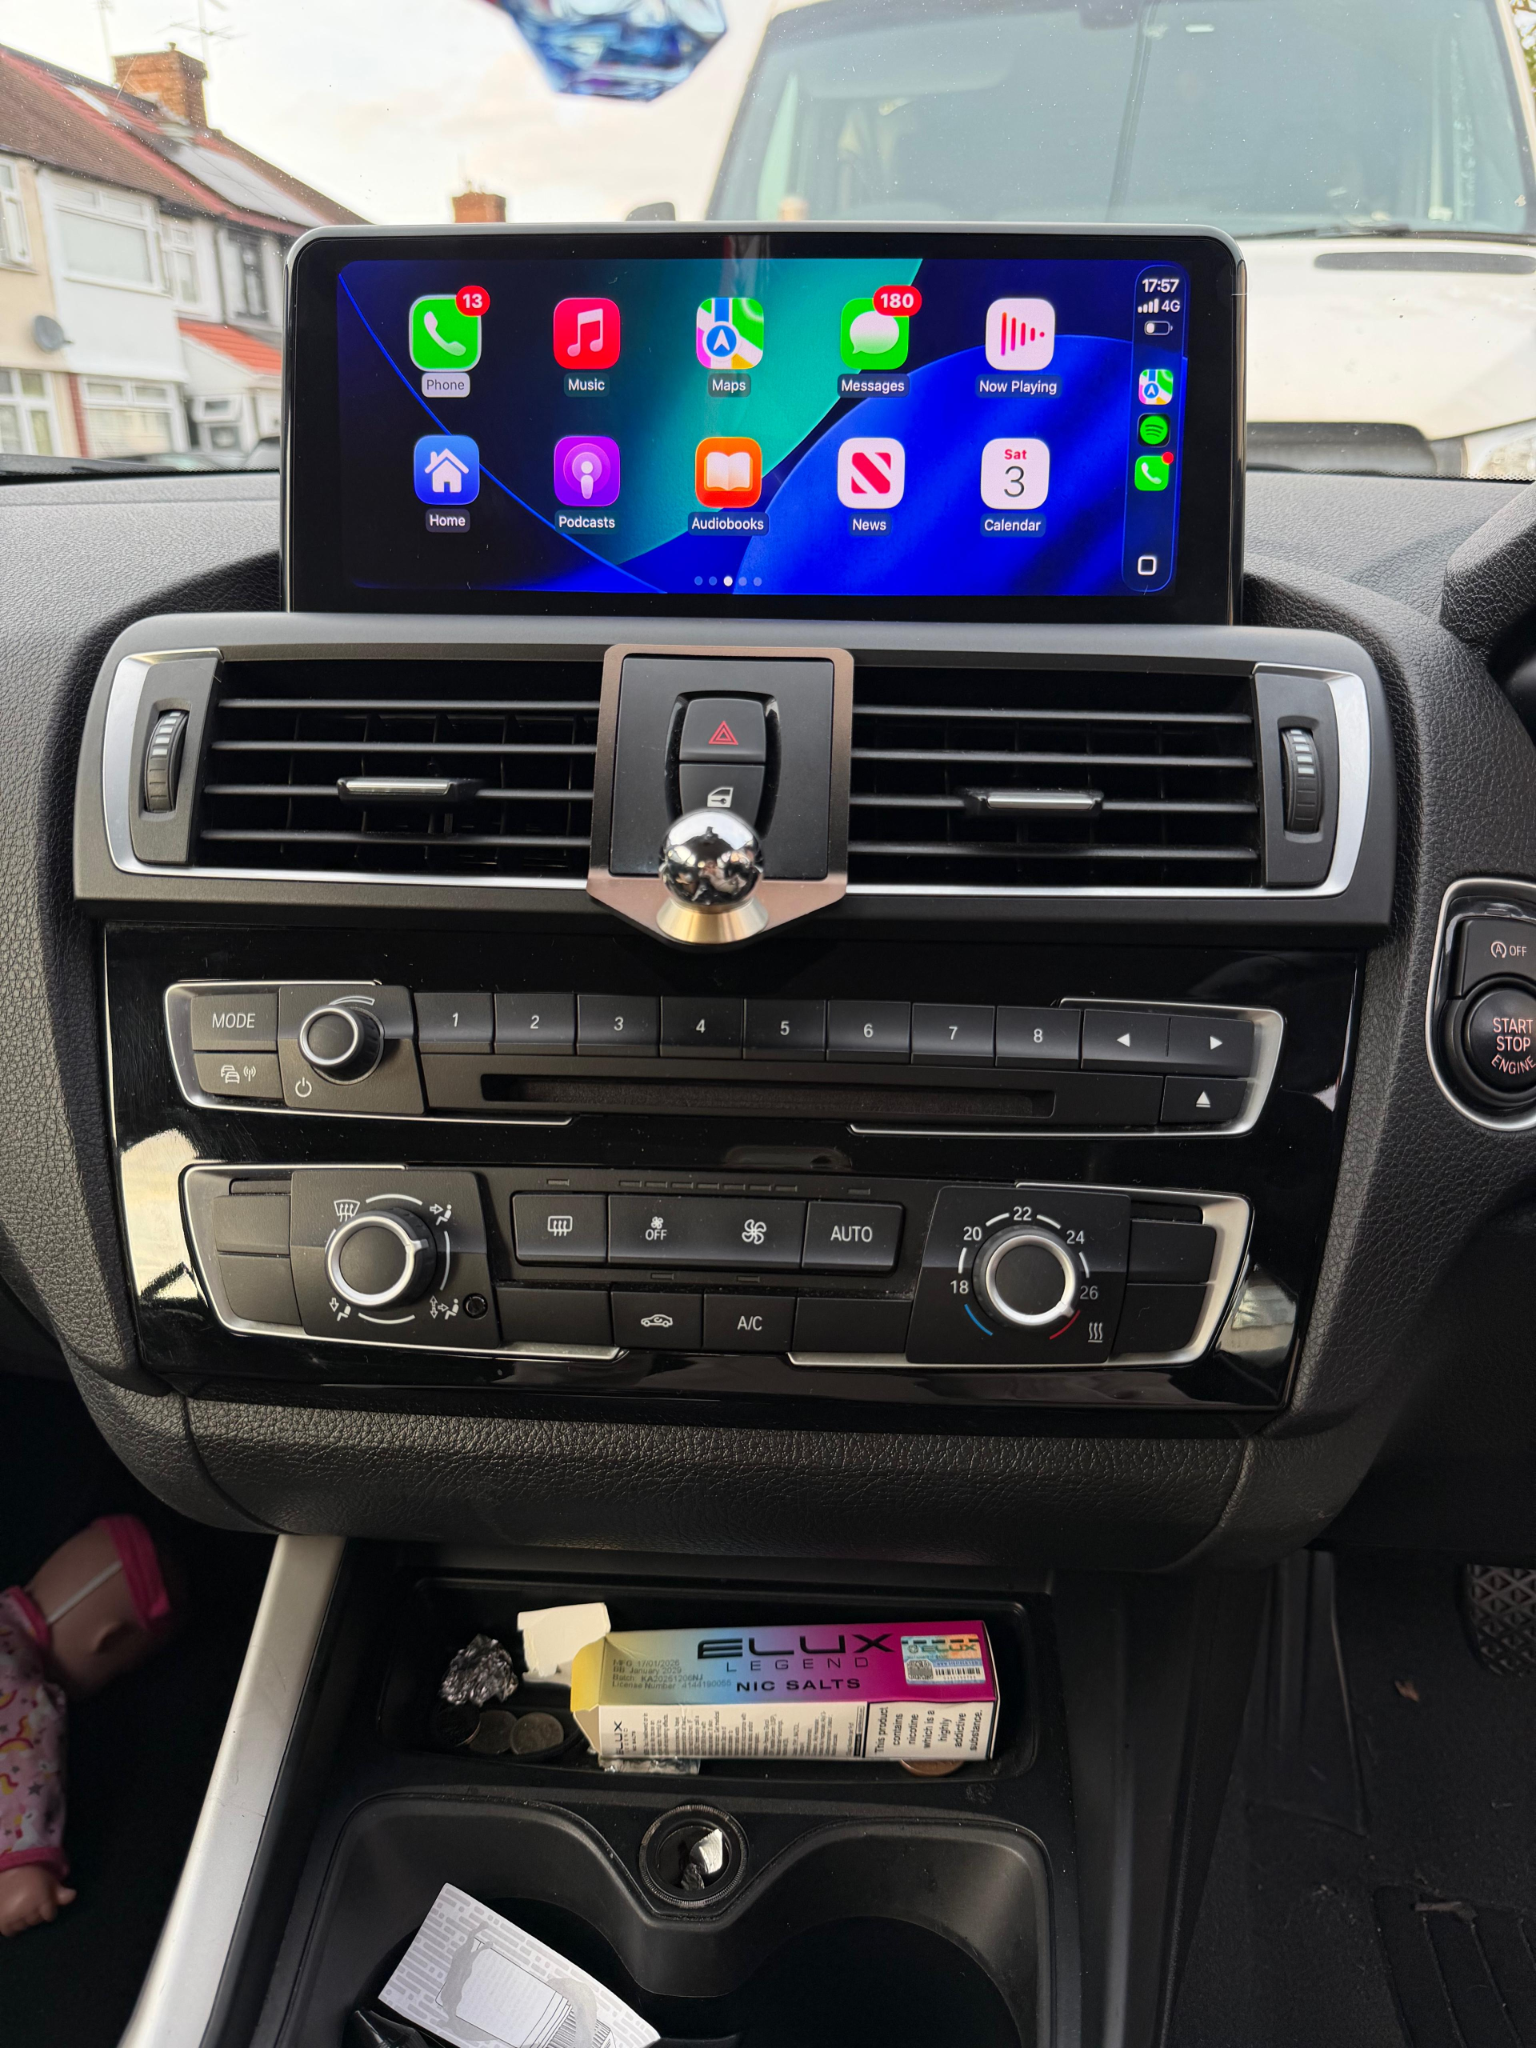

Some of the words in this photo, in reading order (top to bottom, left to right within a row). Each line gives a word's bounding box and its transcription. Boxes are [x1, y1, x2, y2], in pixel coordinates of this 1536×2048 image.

[1142, 279, 1179, 293] 17:57
[462, 294, 483, 308] 13
[880, 293, 914, 308] 180
[1161, 300, 1180, 312] 4G
[426, 379, 465, 391] Phone
[568, 379, 605, 391] Music
[712, 379, 746, 394] Maps
[841, 379, 904, 395] Messages
[979, 381, 1006, 393] Now
[1011, 380, 1057, 395] Playing
[1004, 449, 1027, 461] Sat
[1004, 466, 1025, 497] 3
[430, 514, 466, 527] Home
[559, 516, 615, 529] Podcasts
[692, 517, 764, 530] Audiobooks
[852, 518, 886, 531] News
[984, 519, 1041, 532] Calendar
[1509, 945, 1527, 956] OFF
[212, 1012, 255, 1029] MODE
[451, 1013, 460, 1027] 1
[530, 1015, 540, 1029] 2
[614, 1017, 624, 1031] 3
[696, 1019, 706, 1033] 4
[780, 1021, 790, 1036] 5
[863, 1023, 873, 1038] 6
[948, 1026, 958, 1041] 7
[1033, 1029, 1043, 1043] 8
[1493, 1018, 1533, 1034] START
[1496, 1036, 1531, 1051] STOP
[1491, 1054, 1536, 1074] ENGINE
[1013, 1207, 1032, 1221] 22
[645, 1229, 668, 1241] OFF
[830, 1226, 873, 1242] AUTO
[963, 1227, 982, 1241] 20
[1066, 1230, 1085, 1245] 24
[950, 1280, 969, 1294] 18
[1079, 1285, 1098, 1300] 26
[738, 1315, 762, 1331] A/C
[697, 1633, 894, 1659] ELUX
[921, 1644, 977, 1653] ELUX
[630, 1666, 659, 1675] January
[726, 1656, 869, 1673] LEGEND
[736, 1680, 775, 1692] NIC
[786, 1678, 861, 1691] SALTS
[877, 1707, 889, 1735] product
[892, 1713, 903, 1746] contains
[907, 1714, 919, 1745] nicotine
[938, 1718, 952, 1742] highly
[954, 1713, 966, 1748] addictive
[969, 1709, 983, 1751] substance.
[874, 1737, 886, 1753] This
[922, 1726, 933, 1749] which
